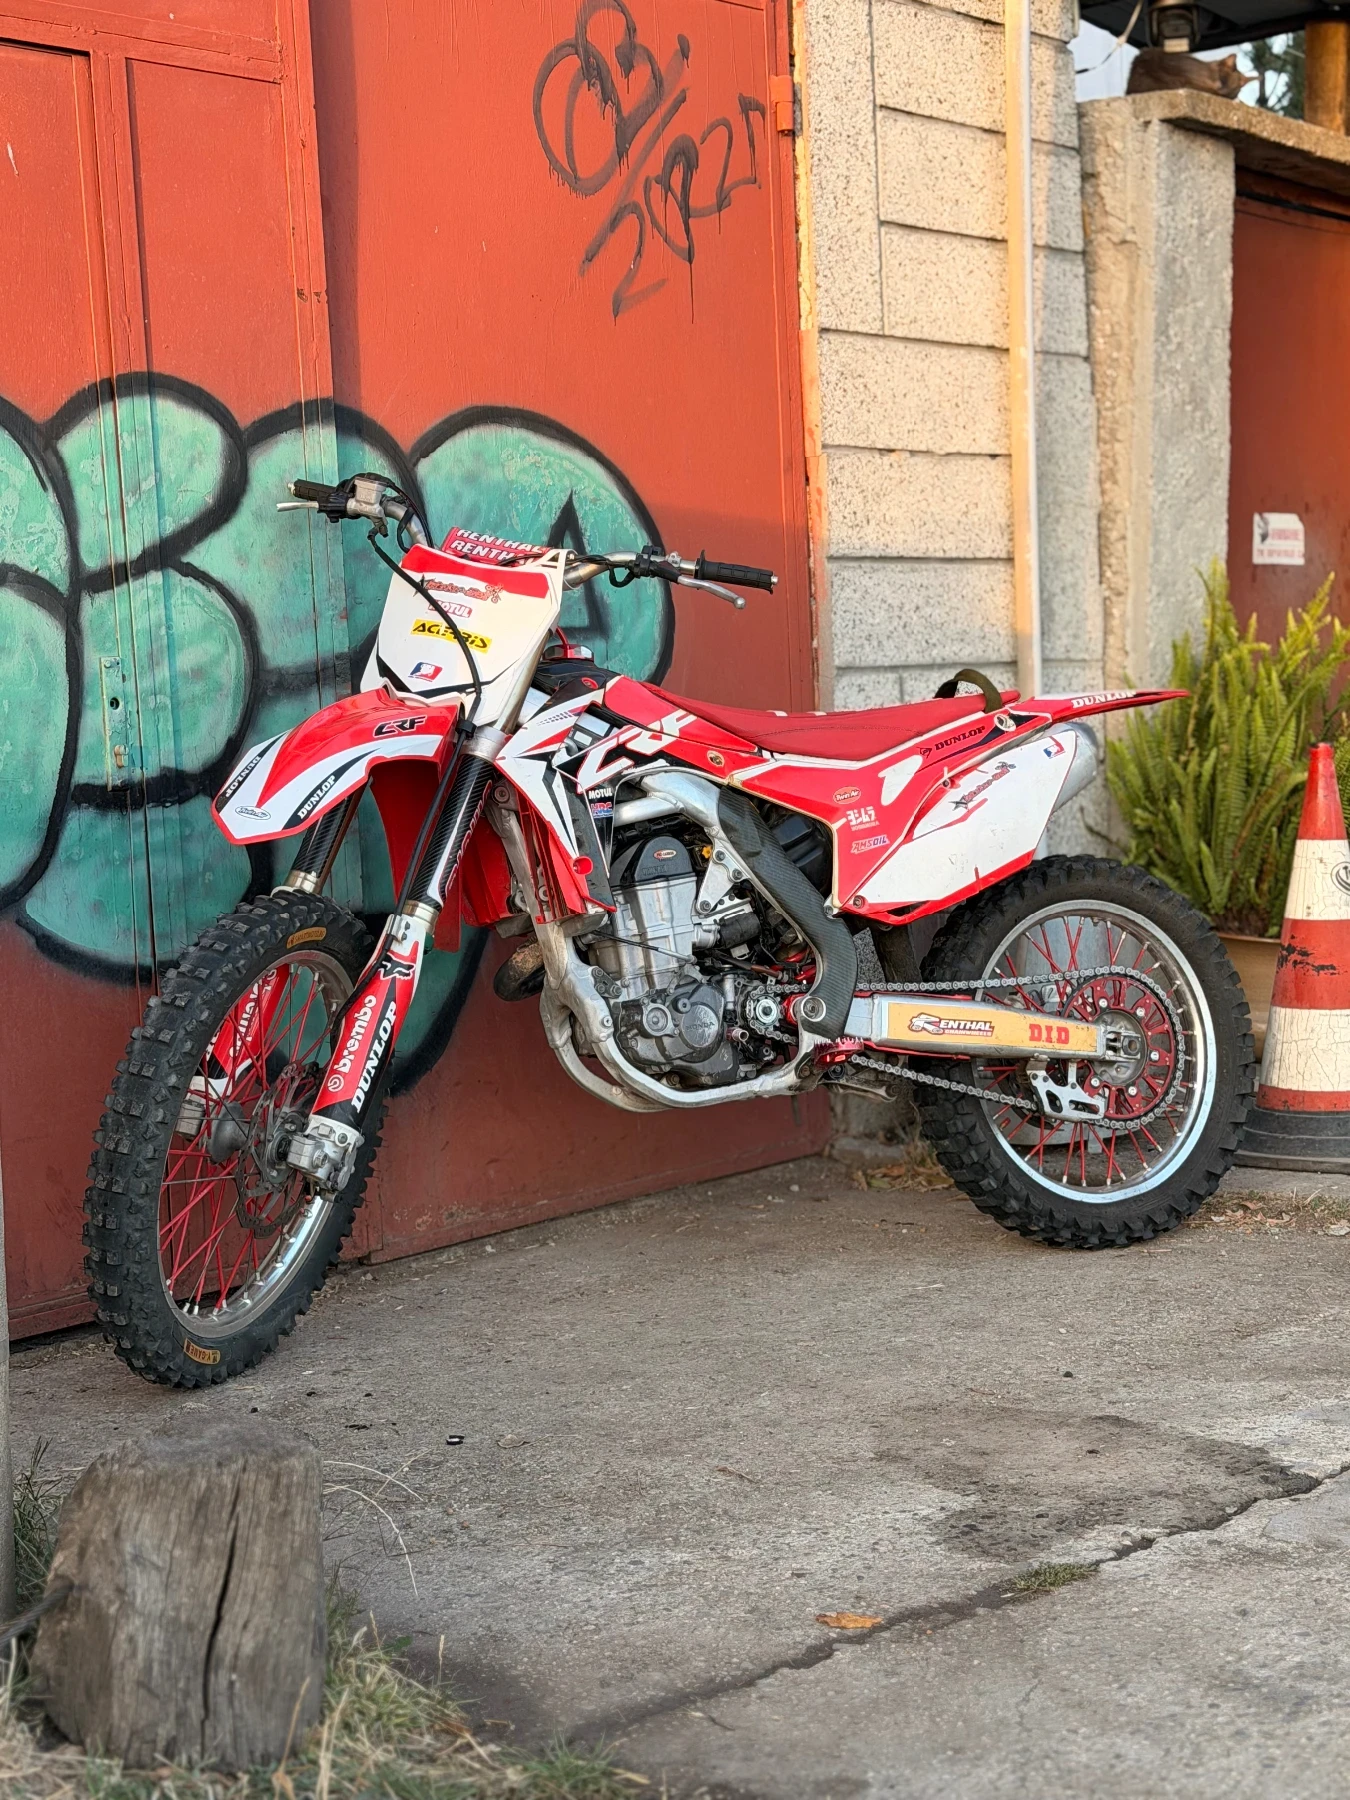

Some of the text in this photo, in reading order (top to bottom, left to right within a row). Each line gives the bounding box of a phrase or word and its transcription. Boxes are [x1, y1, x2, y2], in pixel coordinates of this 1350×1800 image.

[456, 529, 544, 554] RENTHAL
[1071, 691, 1136, 708] DUNLOP
[373, 715, 427, 738] CRF
[934, 725, 986, 751] DUNLOP
[576, 708, 698, 795] CRF
[225, 755, 262, 798] DUNLOP
[297, 775, 336, 820] DUNLOP
[588, 787, 613, 800] MOTUL
[835, 789, 860, 802] Twin Air
[852, 836, 887, 852] AMSOIL
[334, 995, 377, 1074] brembo
[685, 1021, 716, 1031] HONDA
[351, 1001, 397, 1113] DUNLOP
